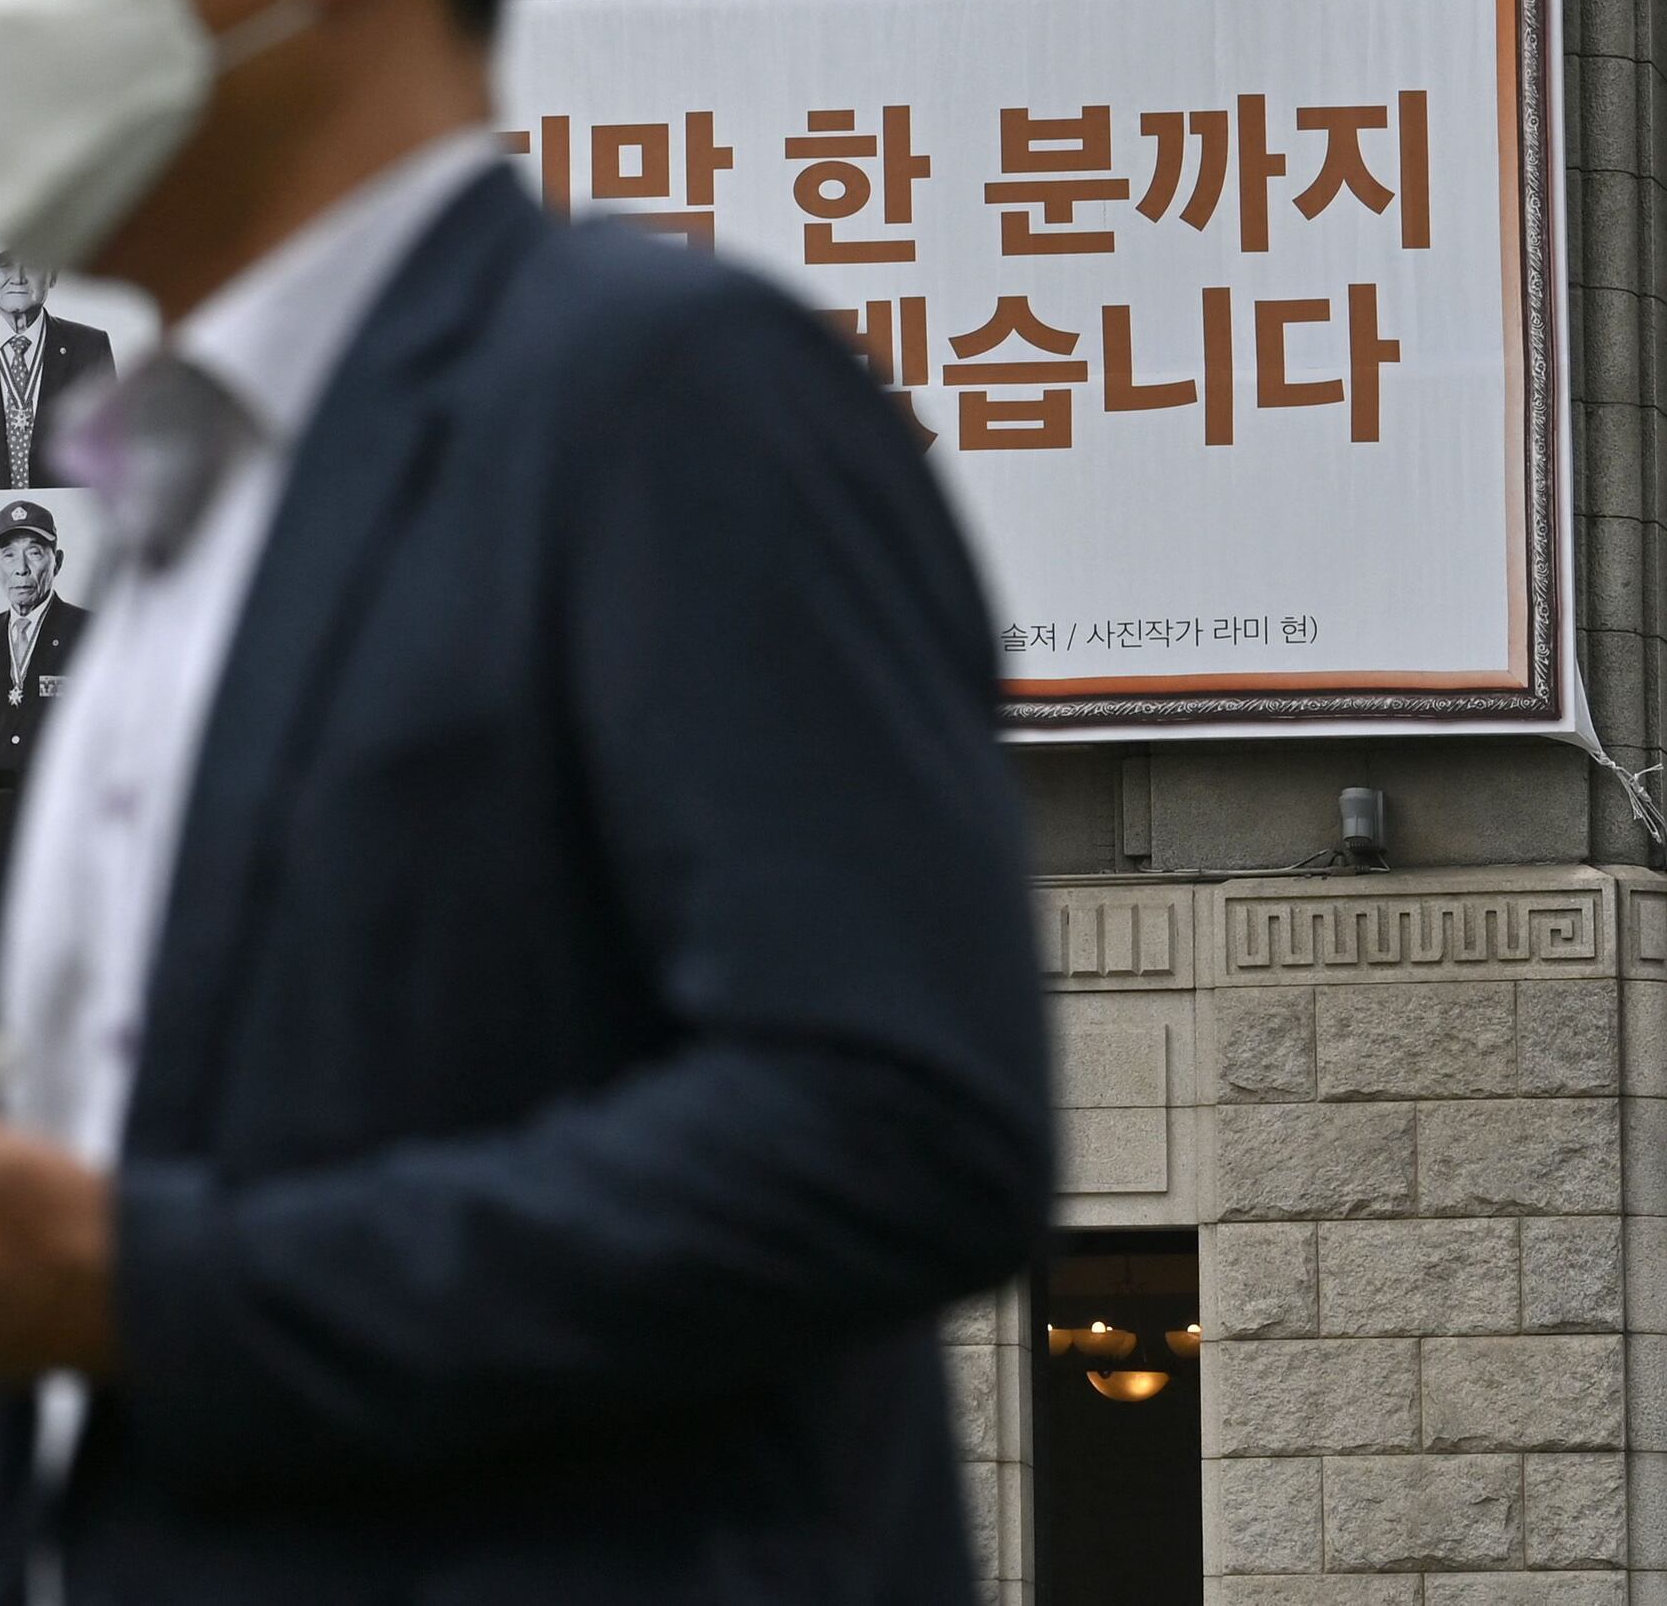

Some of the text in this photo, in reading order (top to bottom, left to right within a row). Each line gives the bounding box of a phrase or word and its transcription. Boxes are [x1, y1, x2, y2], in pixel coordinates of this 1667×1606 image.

[784, 104, 932, 264] 한
[984, 89, 1431, 256] 분까지
[1086, 617, 1204, 650] 사진작가
[1213, 615, 1269, 646] 라미
[1280, 614, 1319, 645] 현)
